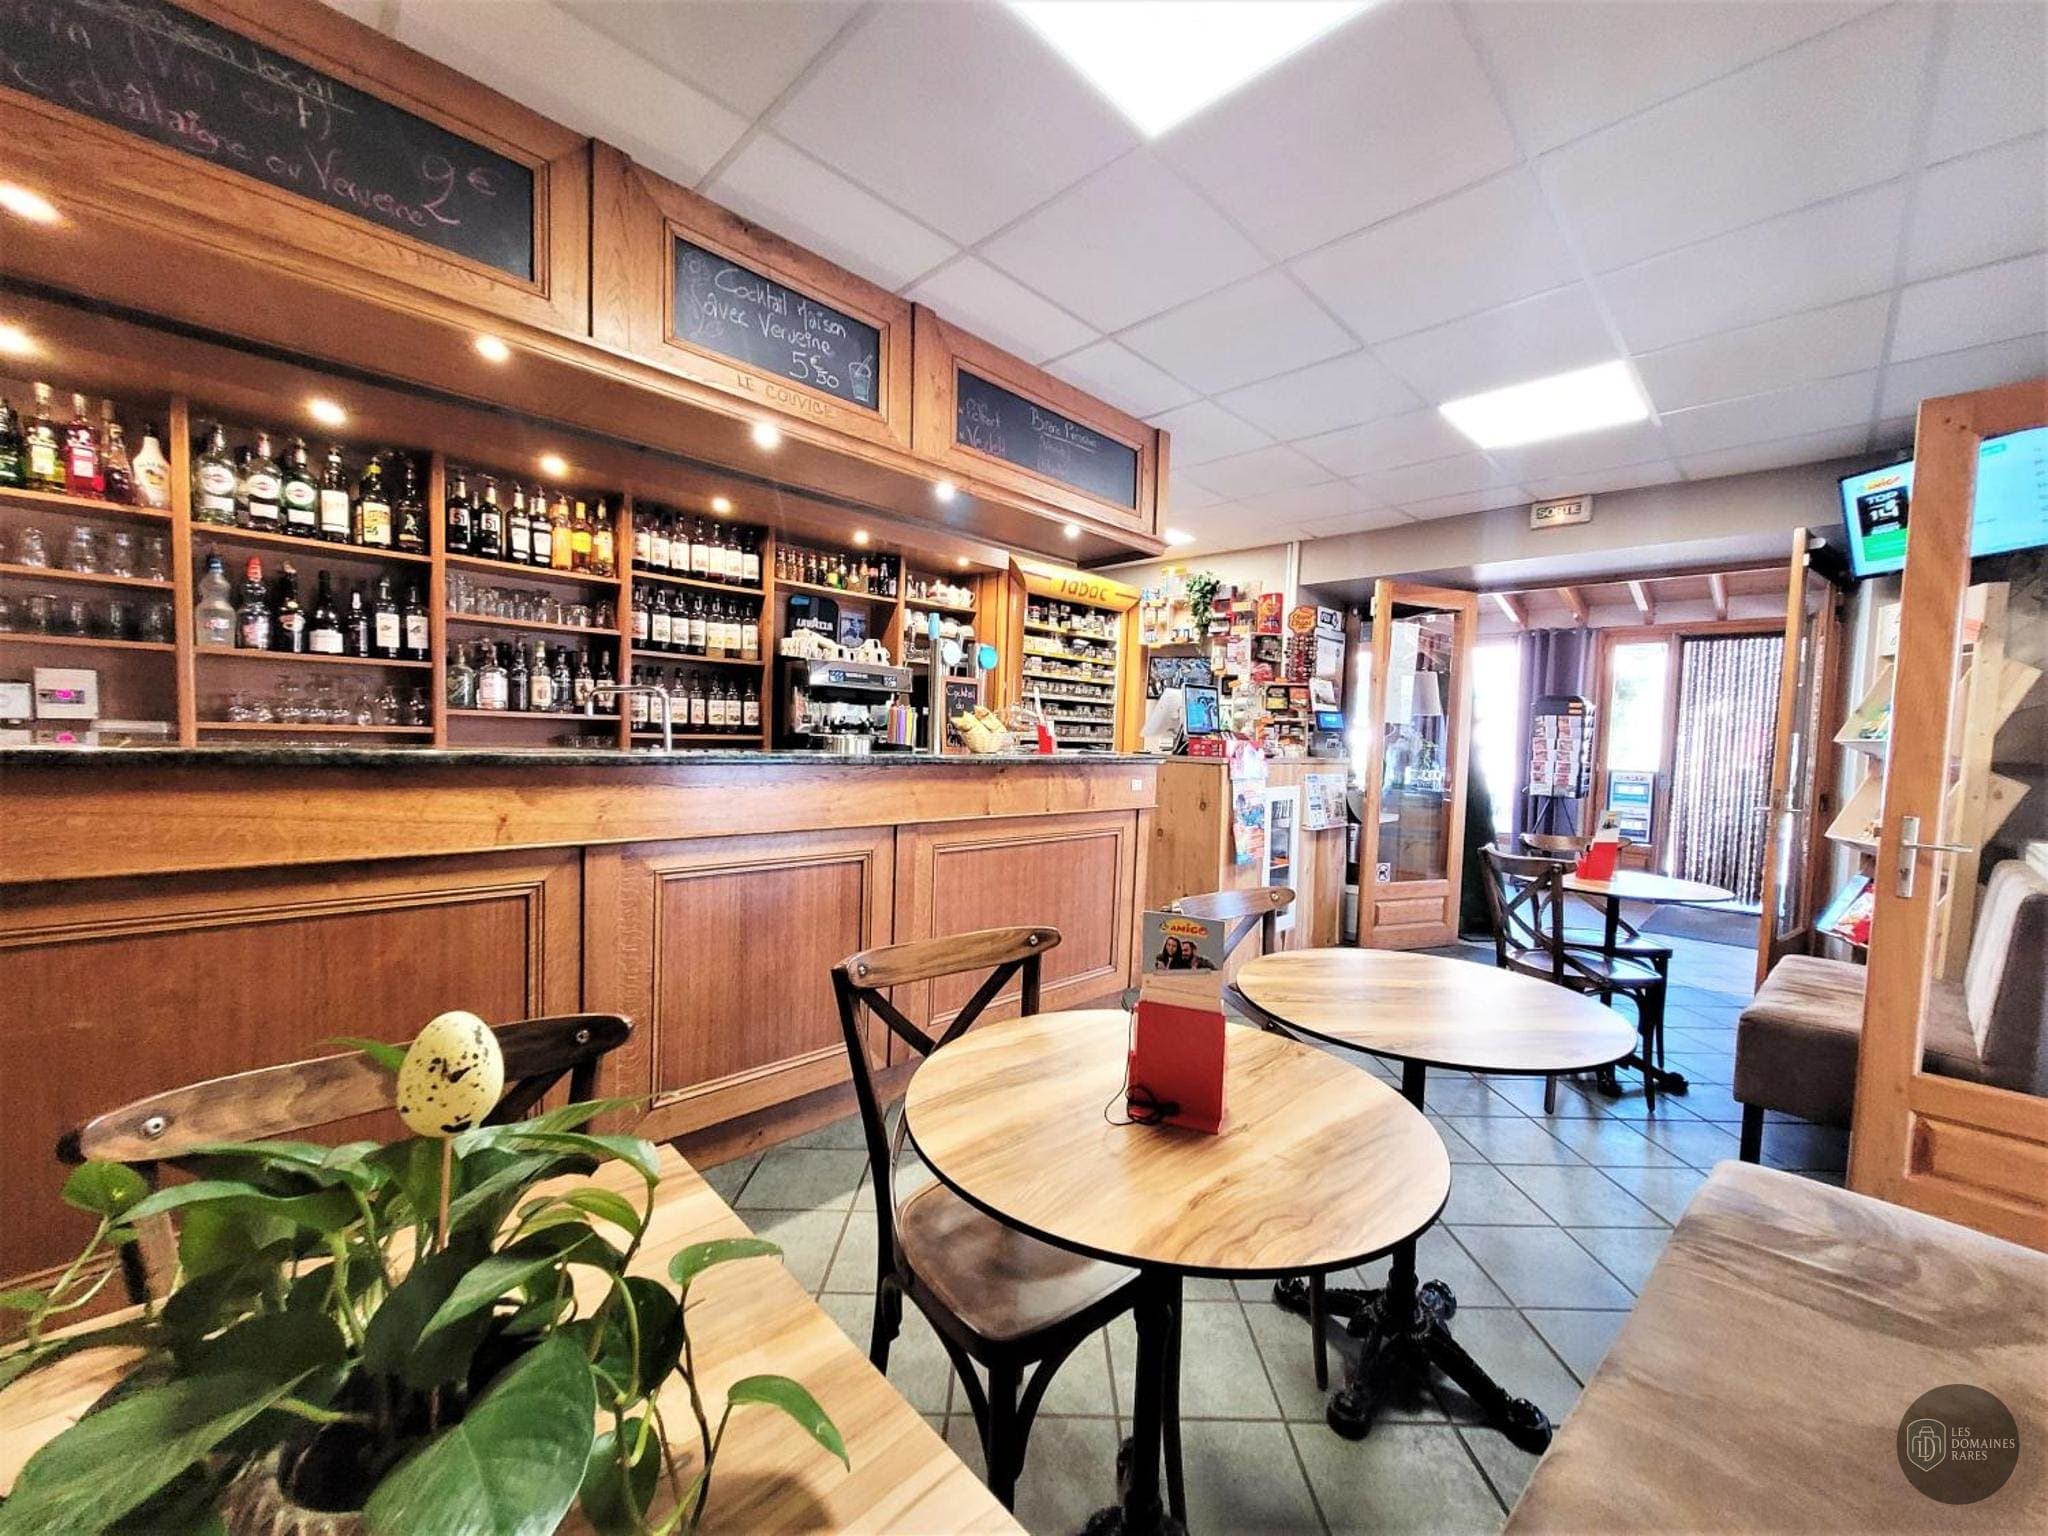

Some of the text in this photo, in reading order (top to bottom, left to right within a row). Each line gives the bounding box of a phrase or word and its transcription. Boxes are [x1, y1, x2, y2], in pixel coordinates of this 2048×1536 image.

[714, 268, 787, 316] Cocktail
[758, 313, 832, 353] Verveine
[1864, 490, 1899, 505] TOP
[454, 512, 465, 524] 51
[1868, 503, 1900, 521] 14
[485, 517, 498, 530] 51
[796, 616, 834, 632] LAVAZZA
[1170, 923, 1208, 936] AMIGO
